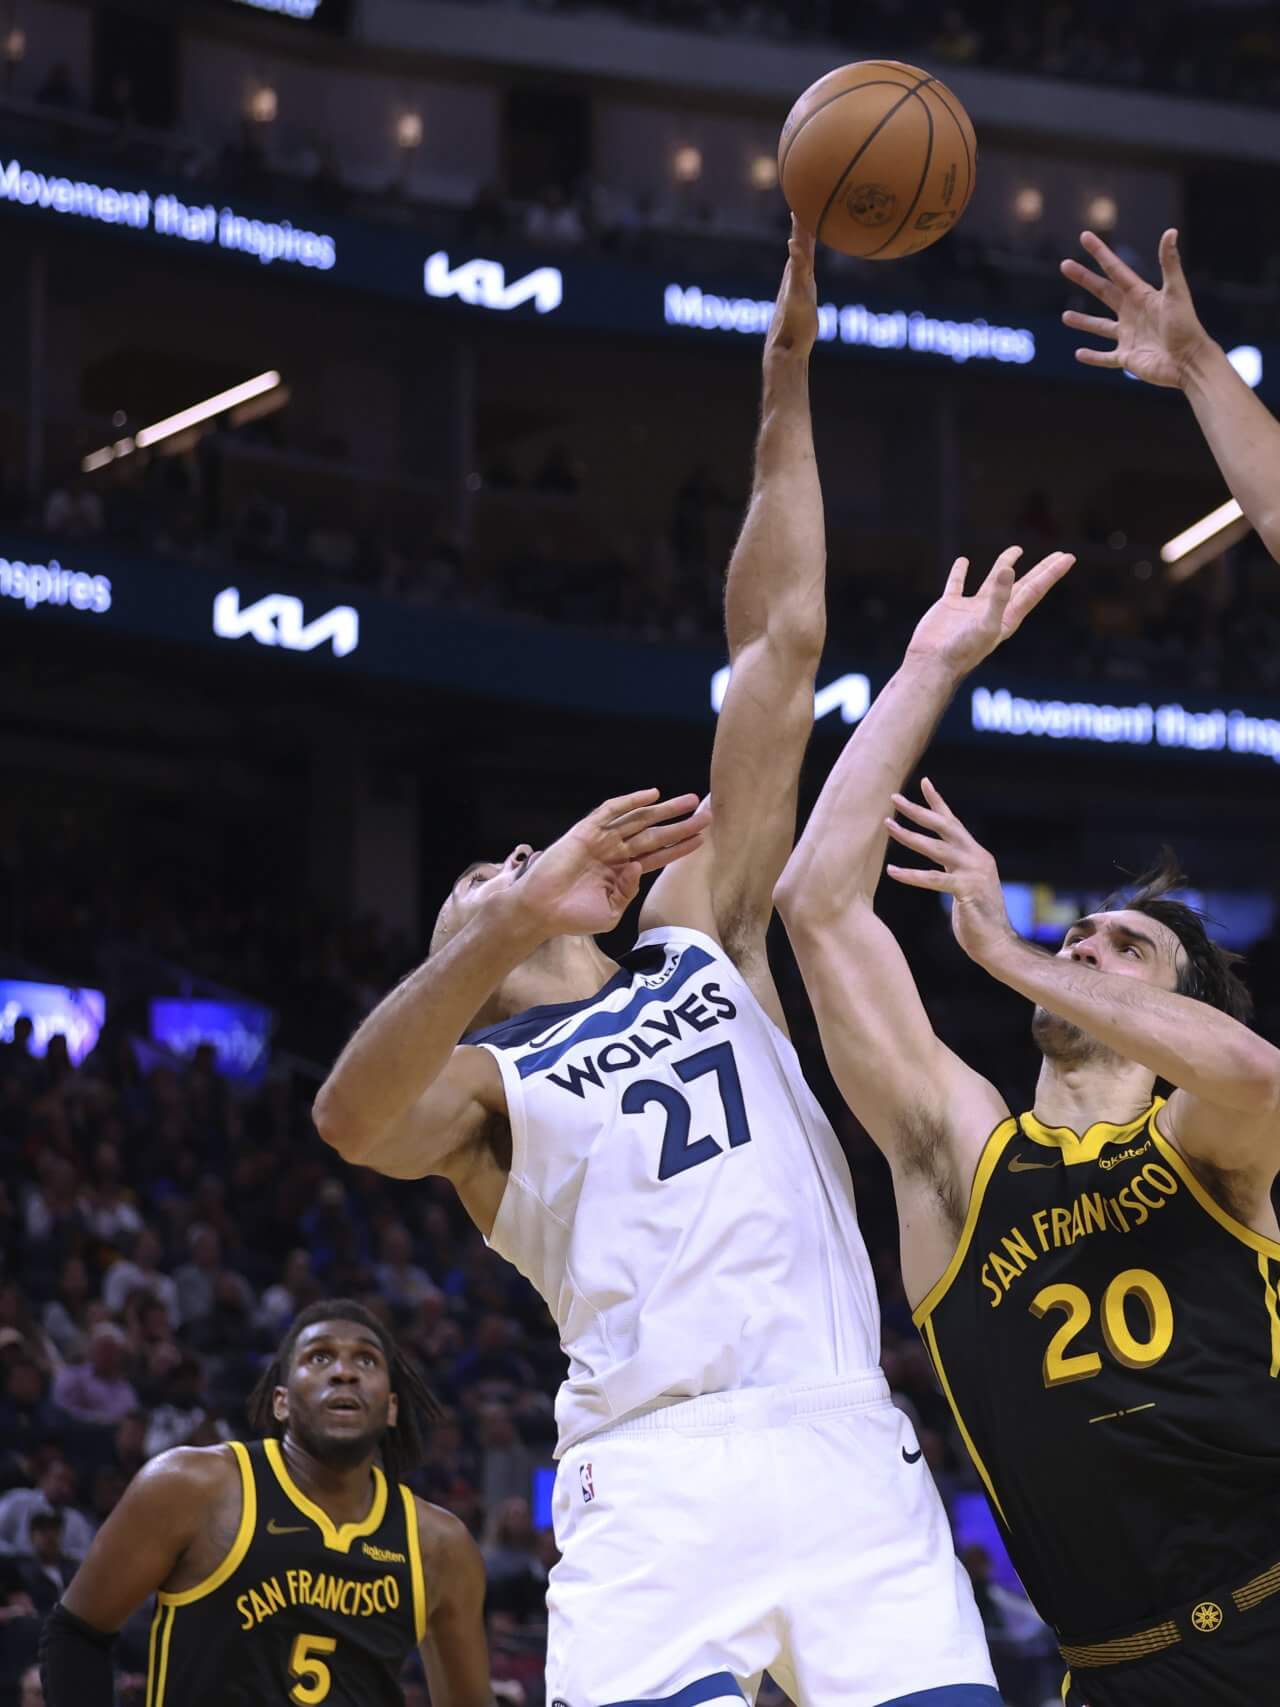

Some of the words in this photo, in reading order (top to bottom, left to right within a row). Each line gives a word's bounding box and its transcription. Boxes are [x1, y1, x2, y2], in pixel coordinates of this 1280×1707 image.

[545, 982, 737, 1099] WOLVES
[621, 1040, 752, 1181] 27
[1099, 1140, 1152, 1171] akuten
[981, 1227, 1038, 1307] SAN
[1028, 1268, 1174, 1389] 20
[236, 1577, 287, 1630] SAN
[285, 1568, 400, 1617] FRANCISCO
[288, 1633, 337, 1706] 5
